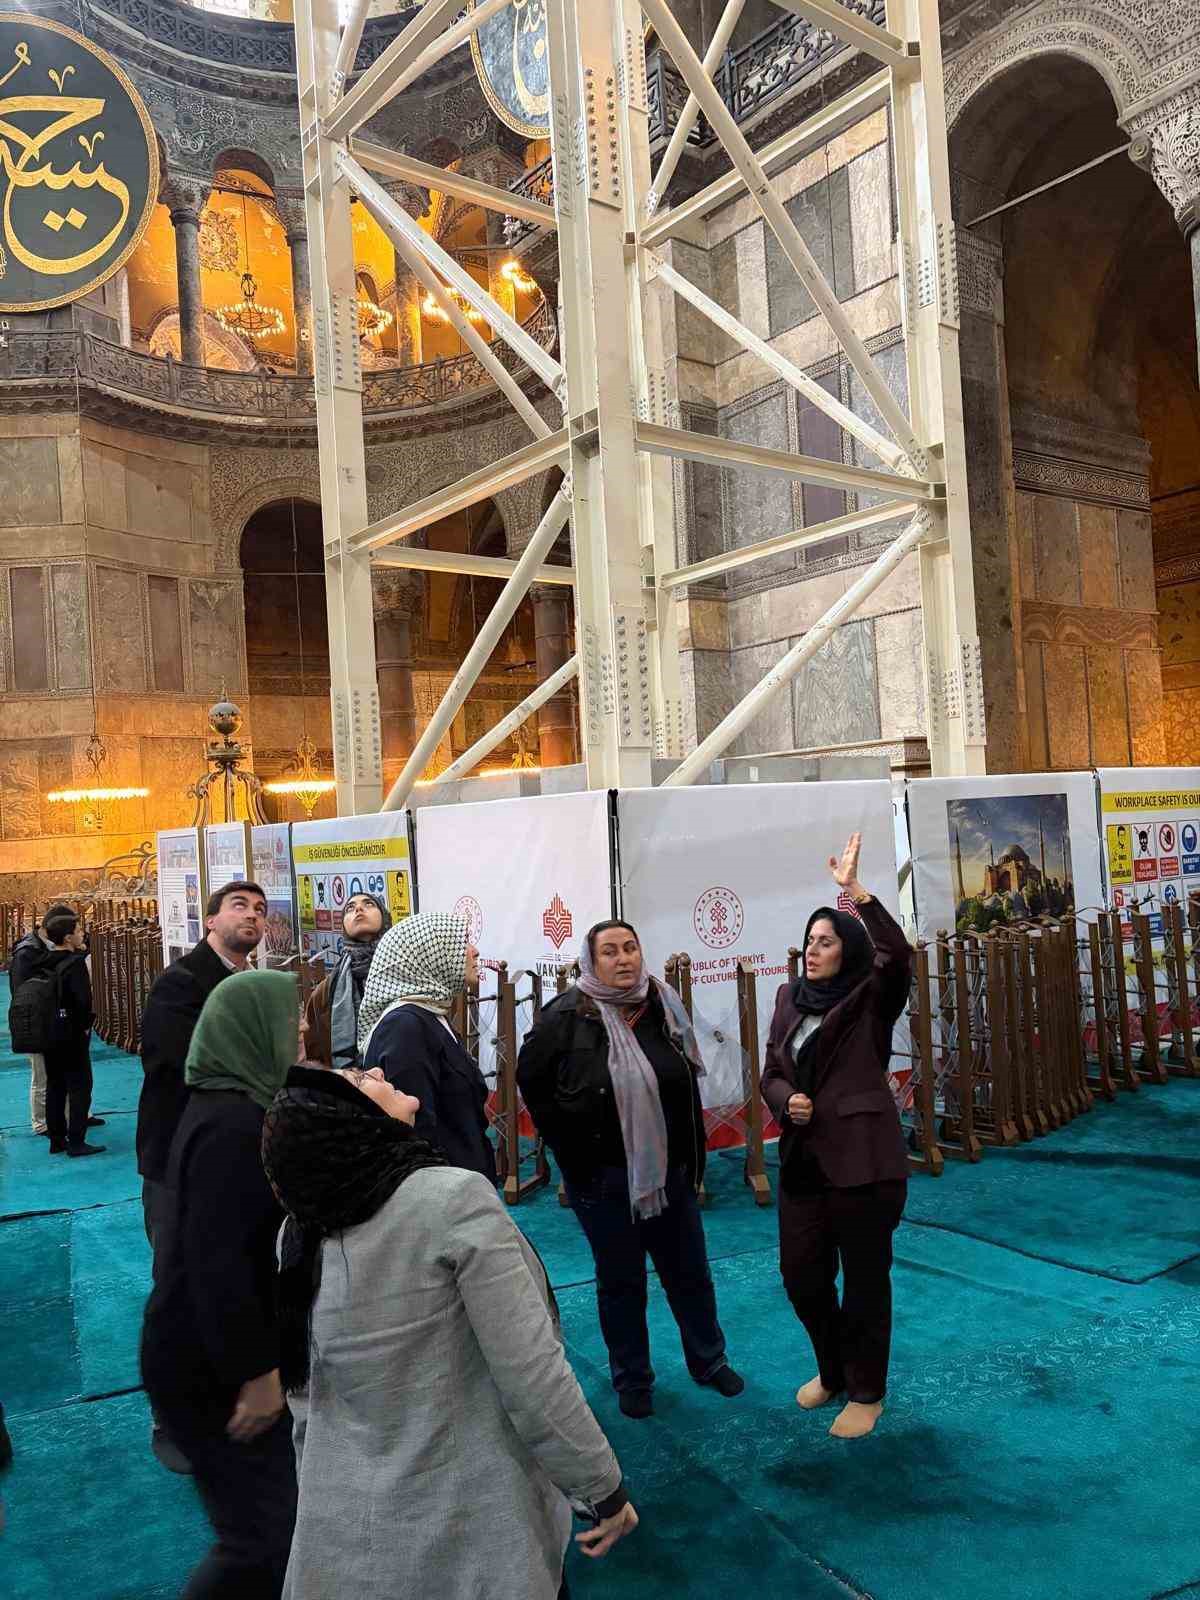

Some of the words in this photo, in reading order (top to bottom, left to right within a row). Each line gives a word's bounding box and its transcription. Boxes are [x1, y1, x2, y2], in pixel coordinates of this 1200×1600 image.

[1114, 796, 1157, 809] WORKPLACE
[1159, 794, 1181, 807] SAFETY
[1182, 793, 1188, 805] IS
[719, 957, 732, 967] OF
[700, 971, 738, 984] CULTURE
